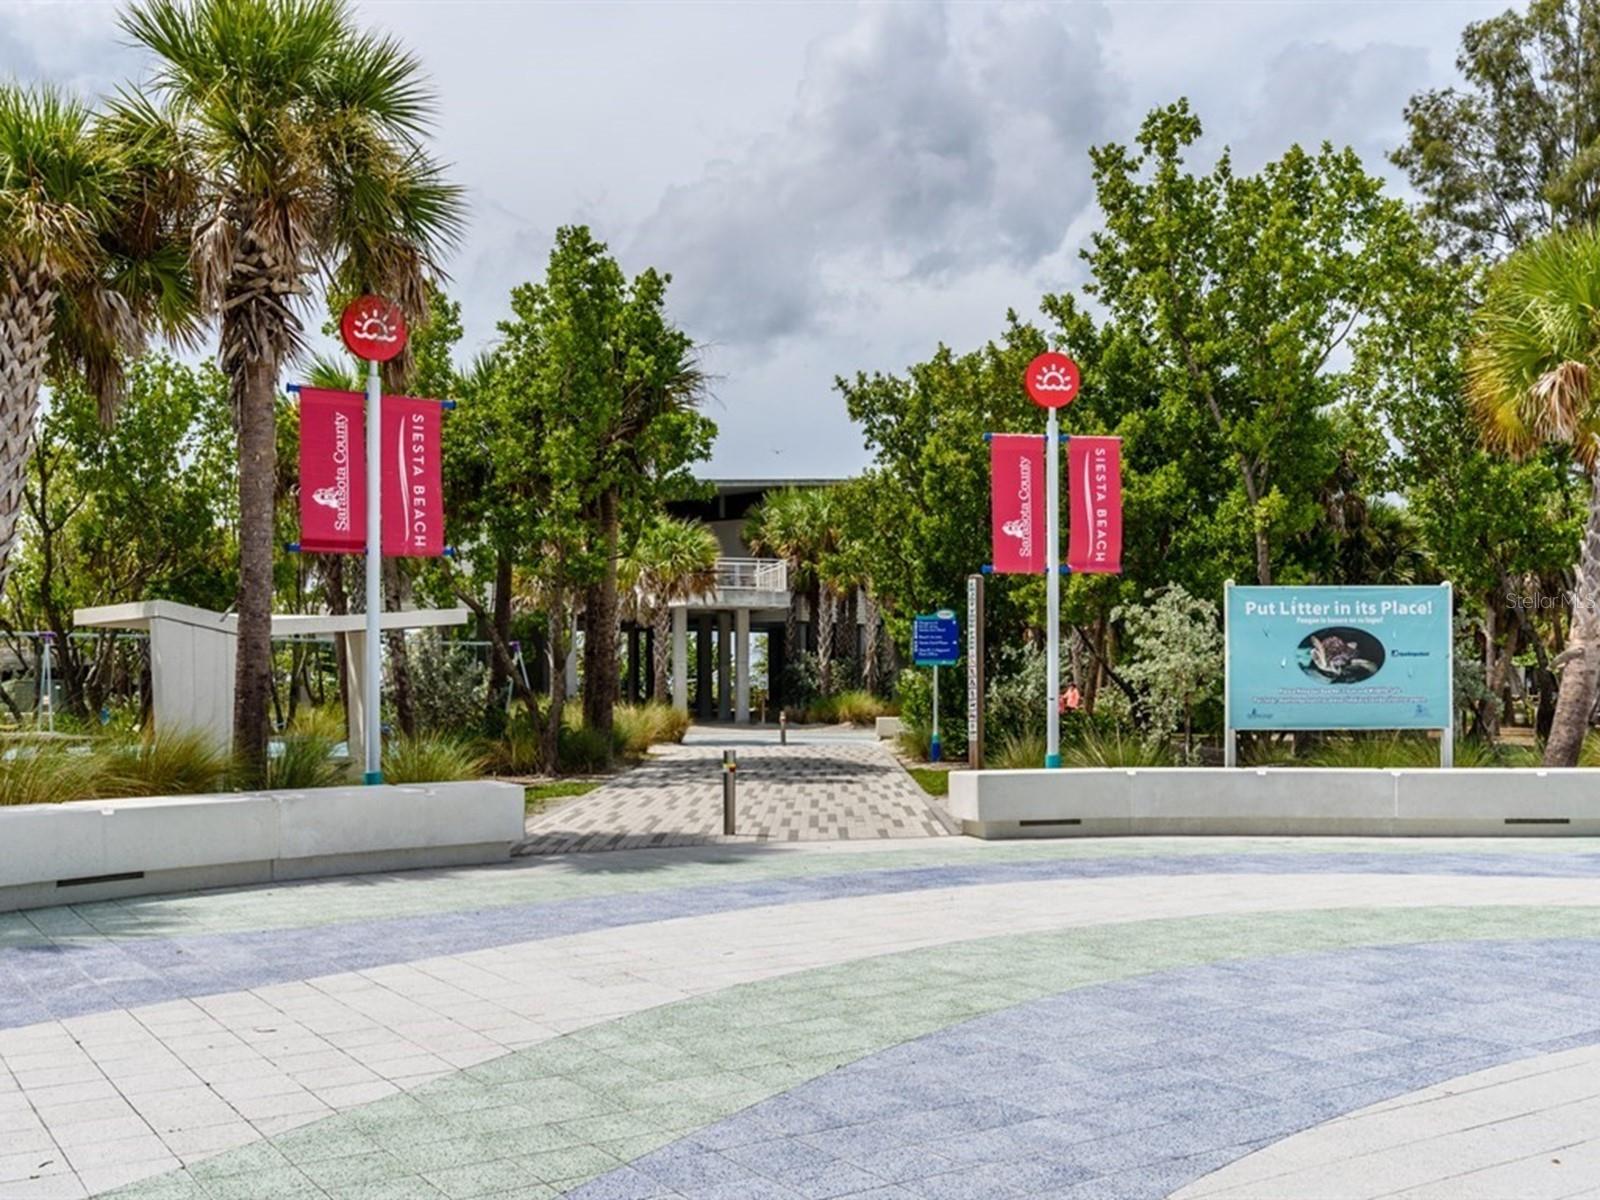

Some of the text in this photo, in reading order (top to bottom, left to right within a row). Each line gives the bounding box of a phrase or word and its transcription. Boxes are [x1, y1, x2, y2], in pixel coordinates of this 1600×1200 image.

[333, 412, 349, 532] Sarasota County
[412, 414, 427, 547] SIESTA BEACH
[1018, 455, 1031, 500] County
[1095, 448, 1107, 561] SIESTA BEACH
[1245, 600, 1433, 615] Put Litter in its Place!
